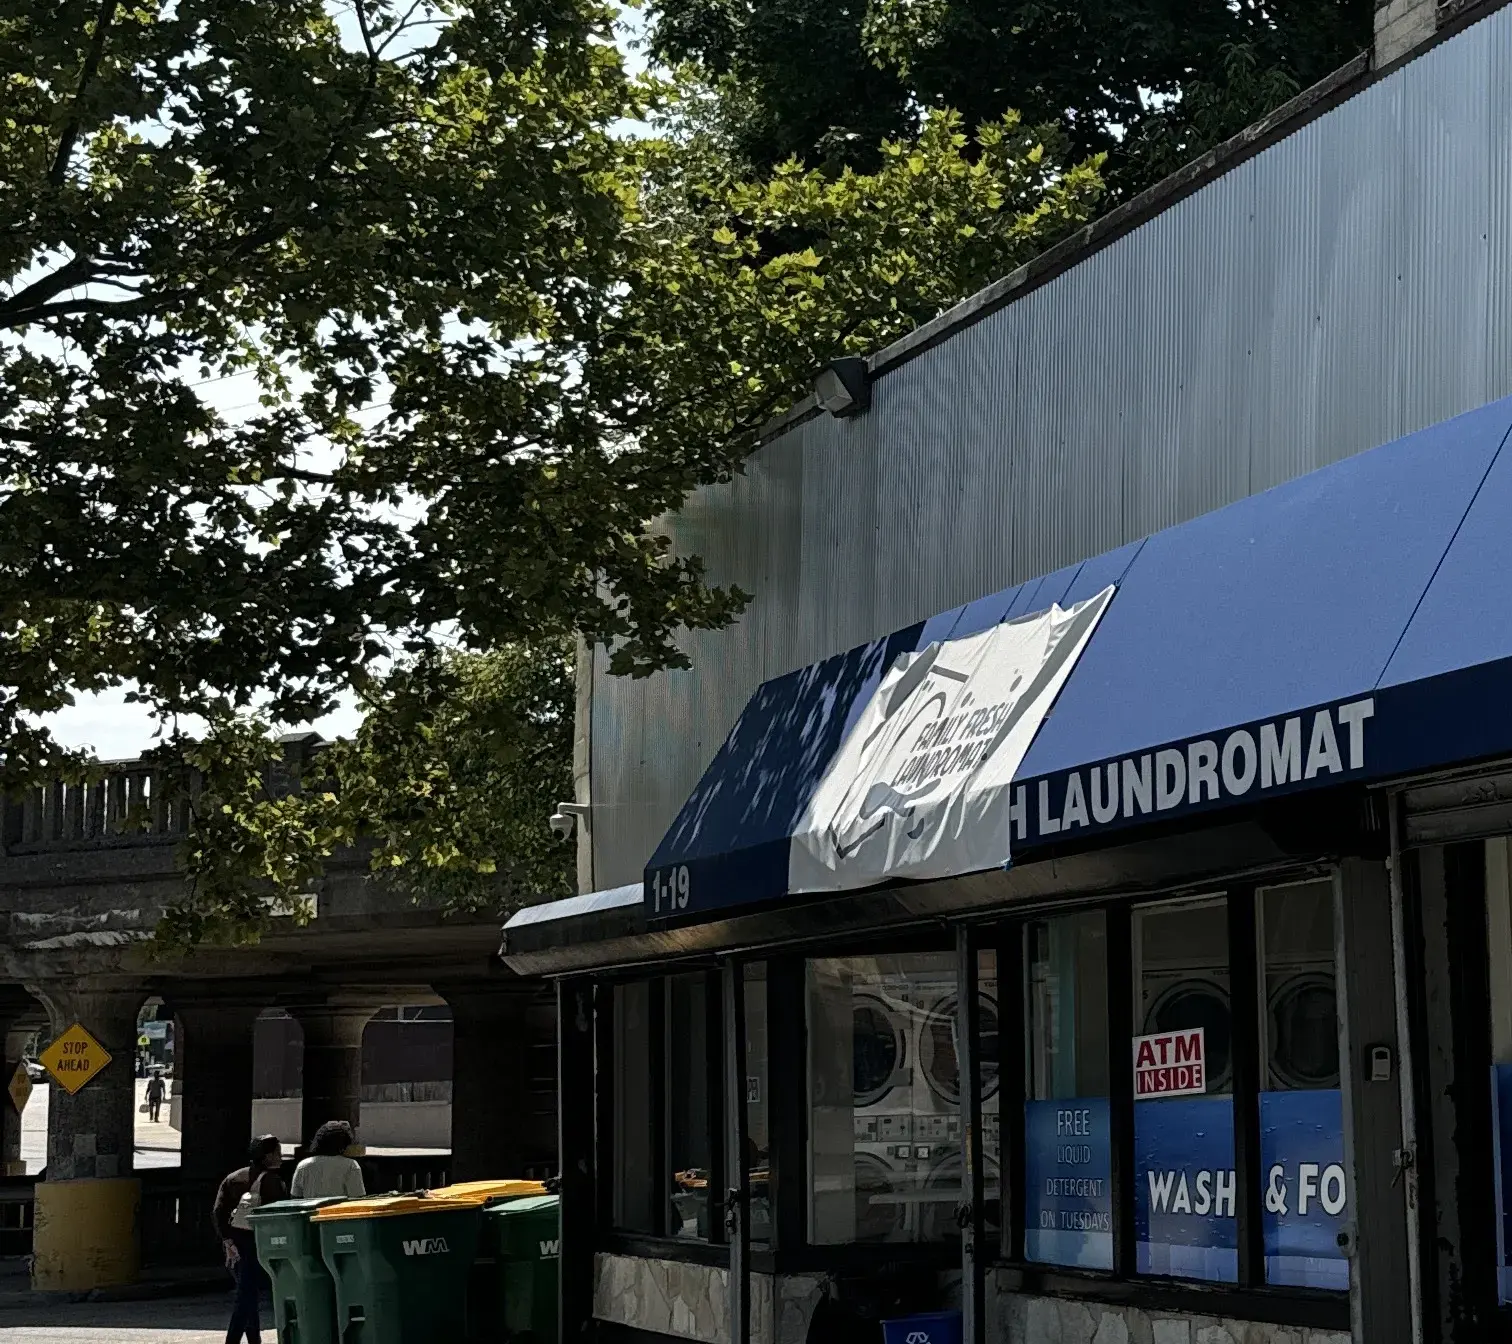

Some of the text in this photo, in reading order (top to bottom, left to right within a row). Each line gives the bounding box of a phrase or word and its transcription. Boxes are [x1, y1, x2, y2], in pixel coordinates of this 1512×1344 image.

[910, 701, 1014, 753] FAMILY FRESH
[891, 737, 993, 787] LAUNDROMAT
[1038, 697, 1375, 836] LAUNDROMAT
[652, 864, 690, 913] 1-19
[62, 1041, 89, 1055] STOP
[1136, 1033, 1202, 1068] ATM
[56, 1058, 90, 1072] AHEAD
[1137, 1065, 1202, 1094] INSIDE
[1057, 1109, 1091, 1136] FREE
[1057, 1144, 1091, 1167] LIQUID
[1046, 1177, 1104, 1197] DETERGENT
[1148, 1169, 1236, 1217] WASH
[1265, 1164, 1289, 1216] &
[1040, 1209, 1109, 1231] ON TUESDAYS
[402, 1237, 450, 1256] WM
